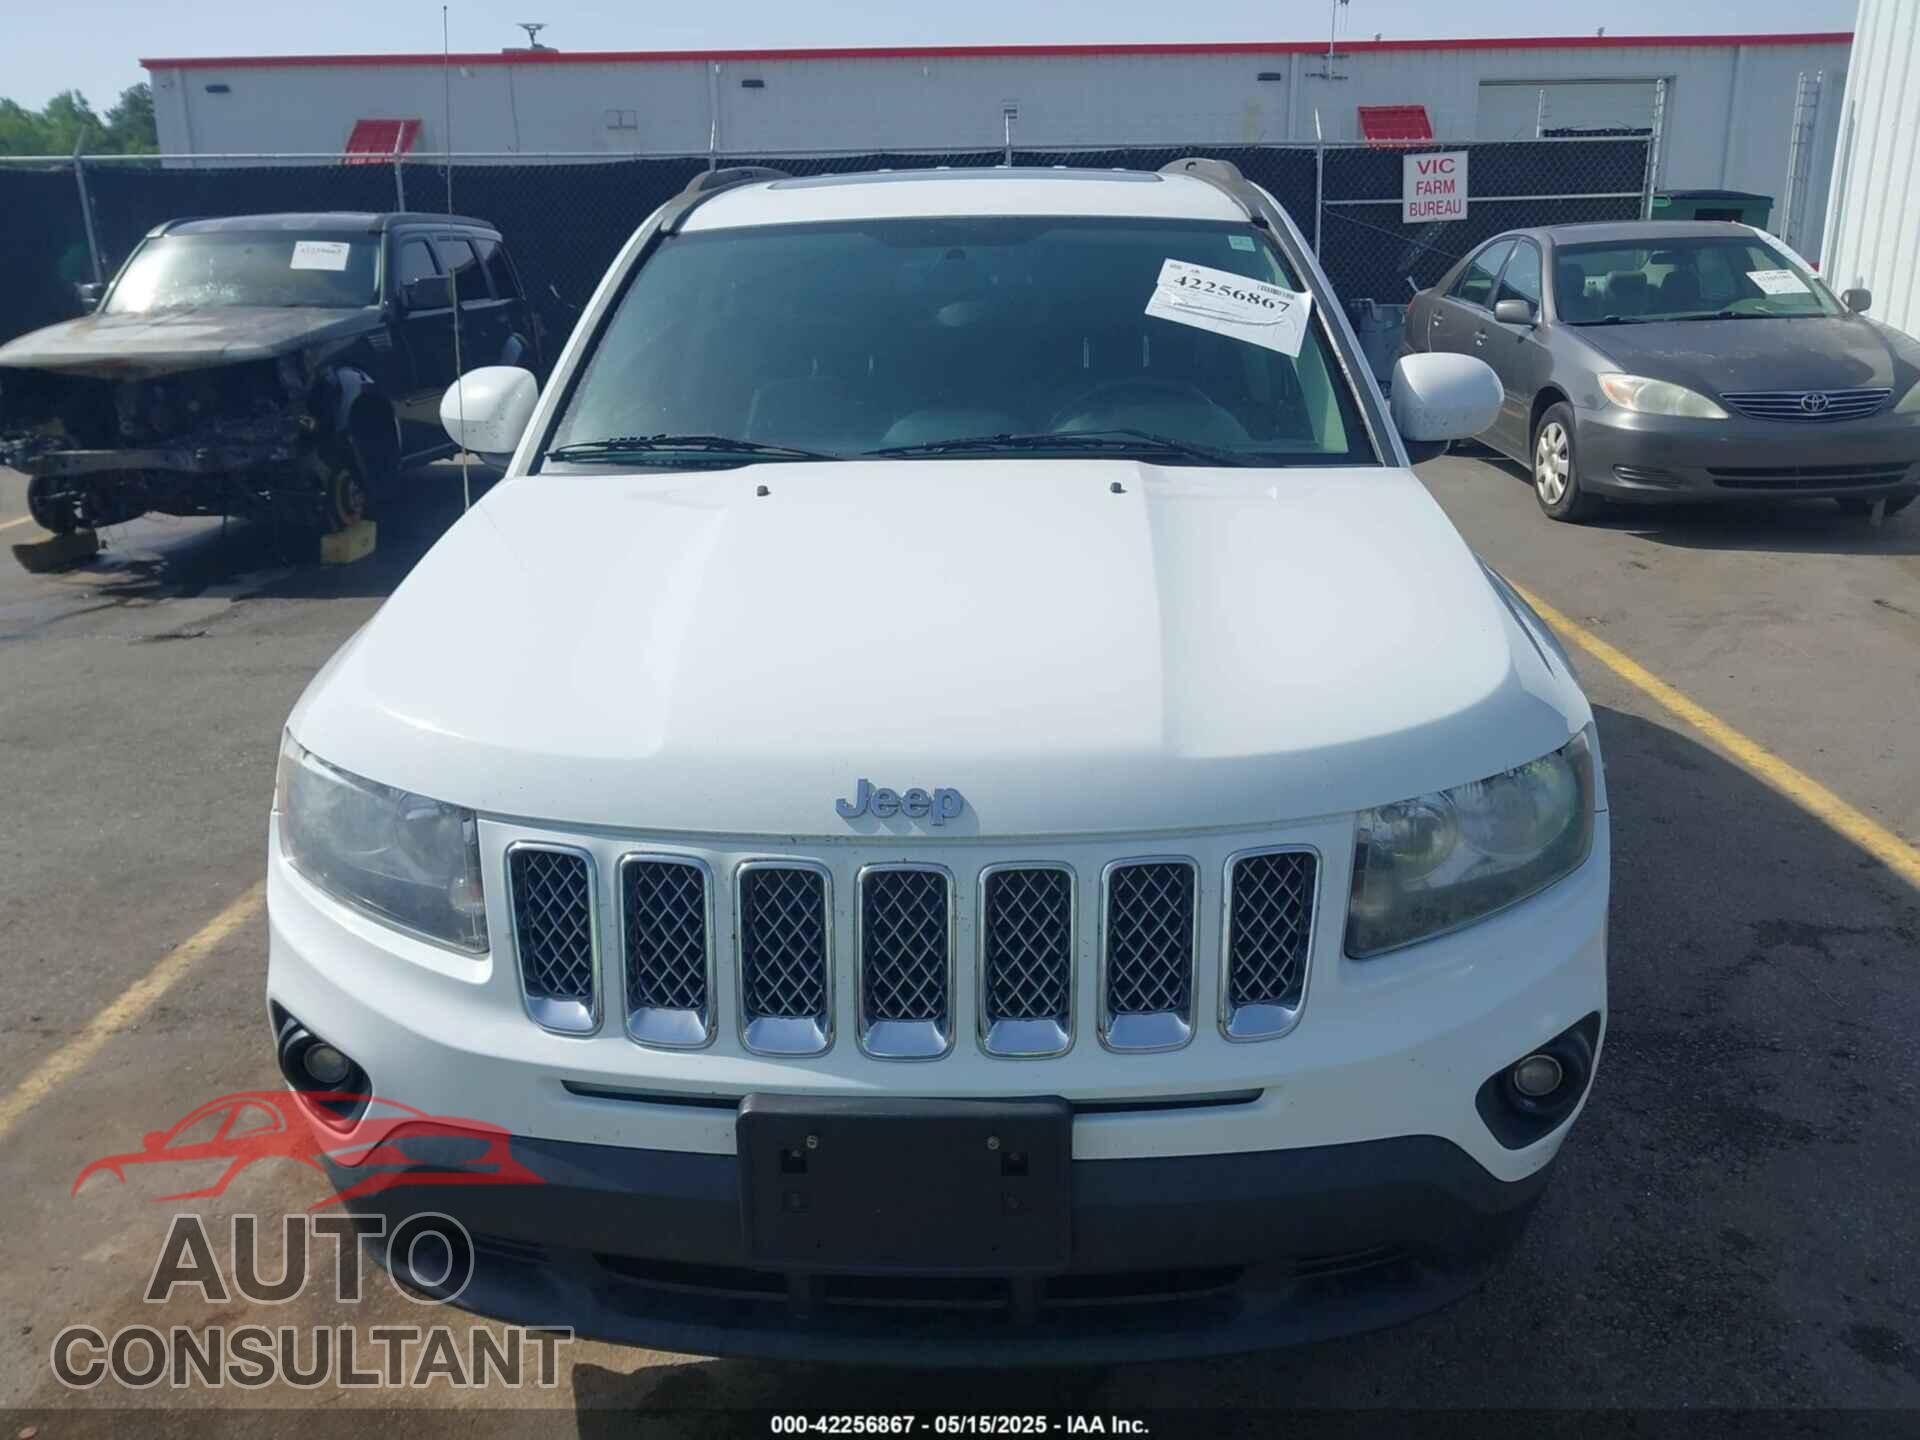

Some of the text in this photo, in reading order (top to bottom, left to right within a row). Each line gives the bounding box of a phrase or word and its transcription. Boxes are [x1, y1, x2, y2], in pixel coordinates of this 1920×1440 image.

[1416, 158, 1456, 175] VIC
[1416, 180, 1456, 196] FARM
[1409, 199, 1462, 217] BUREAU
[1173, 275, 1290, 313] 42256867
[835, 777, 964, 827] Jeep
